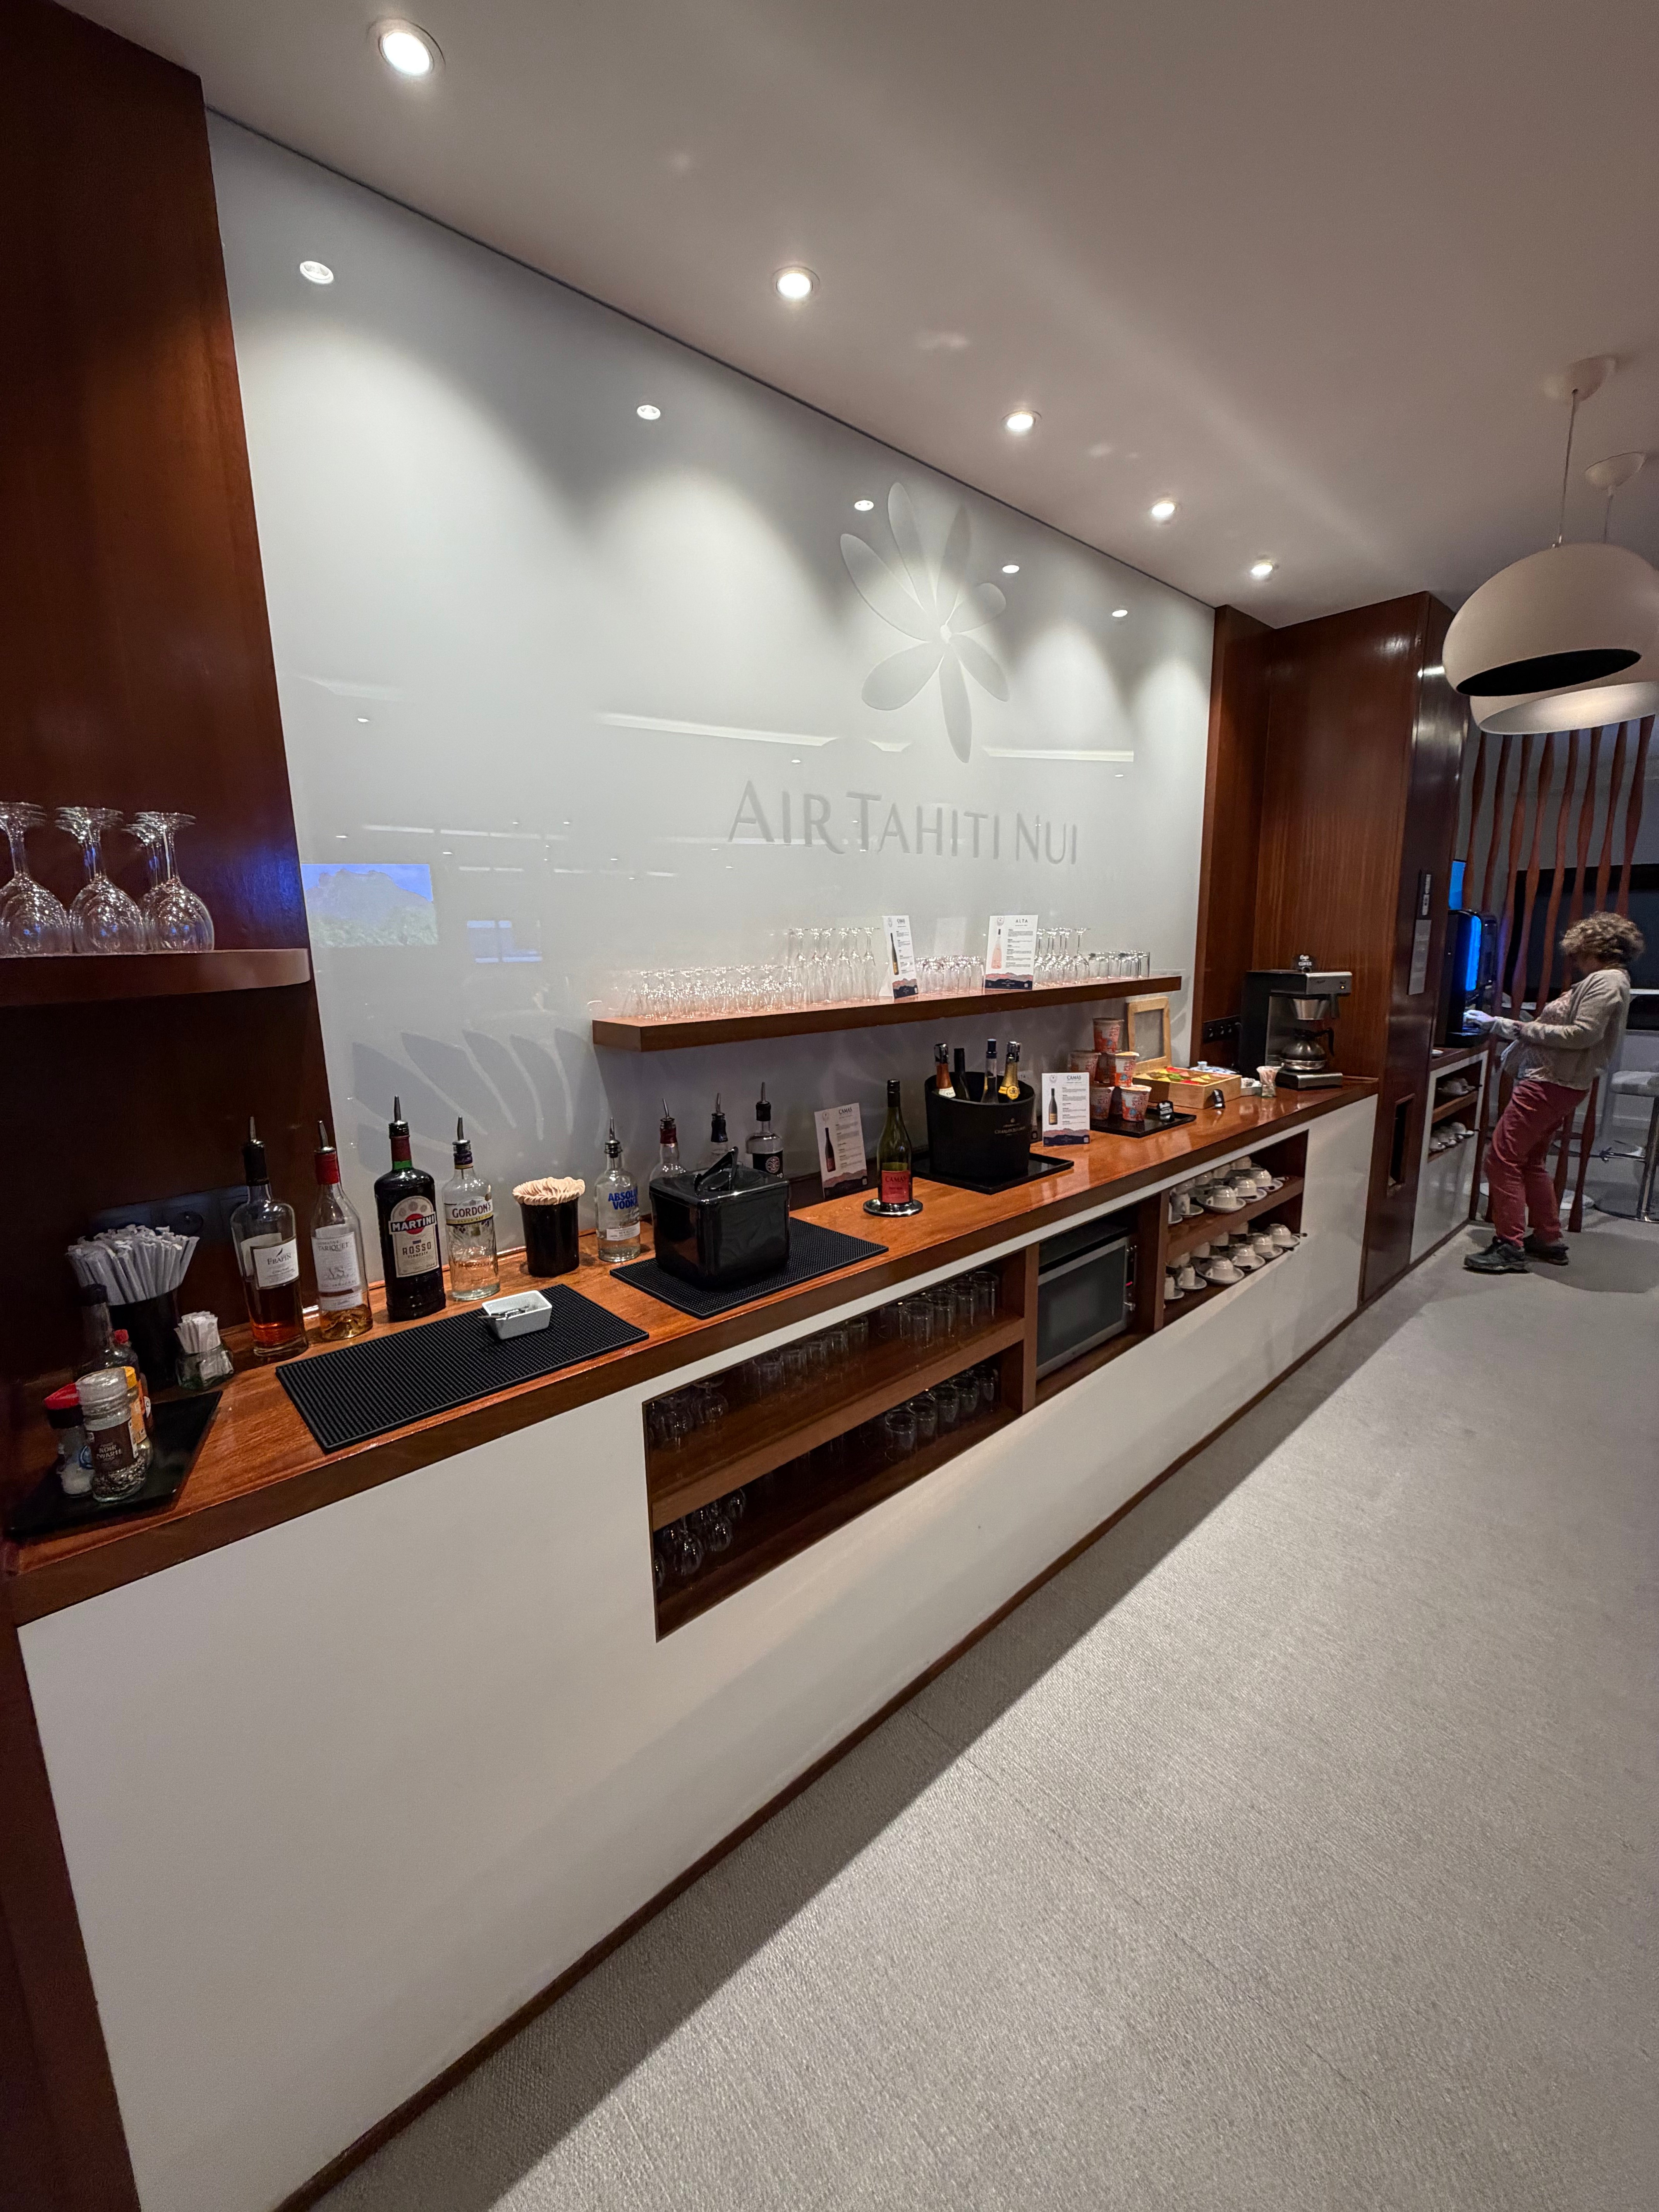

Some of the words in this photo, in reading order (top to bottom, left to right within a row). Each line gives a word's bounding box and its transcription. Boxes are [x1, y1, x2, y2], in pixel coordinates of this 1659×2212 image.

[728, 780, 845, 855] AIR
[847, 792, 999, 860] TAHITI
[1015, 812, 1077, 865] NUI
[392, 1215, 434, 1231] MARTINI
[318, 1242, 349, 1252] TARIQUET
[402, 1242, 431, 1255] ROSSO
